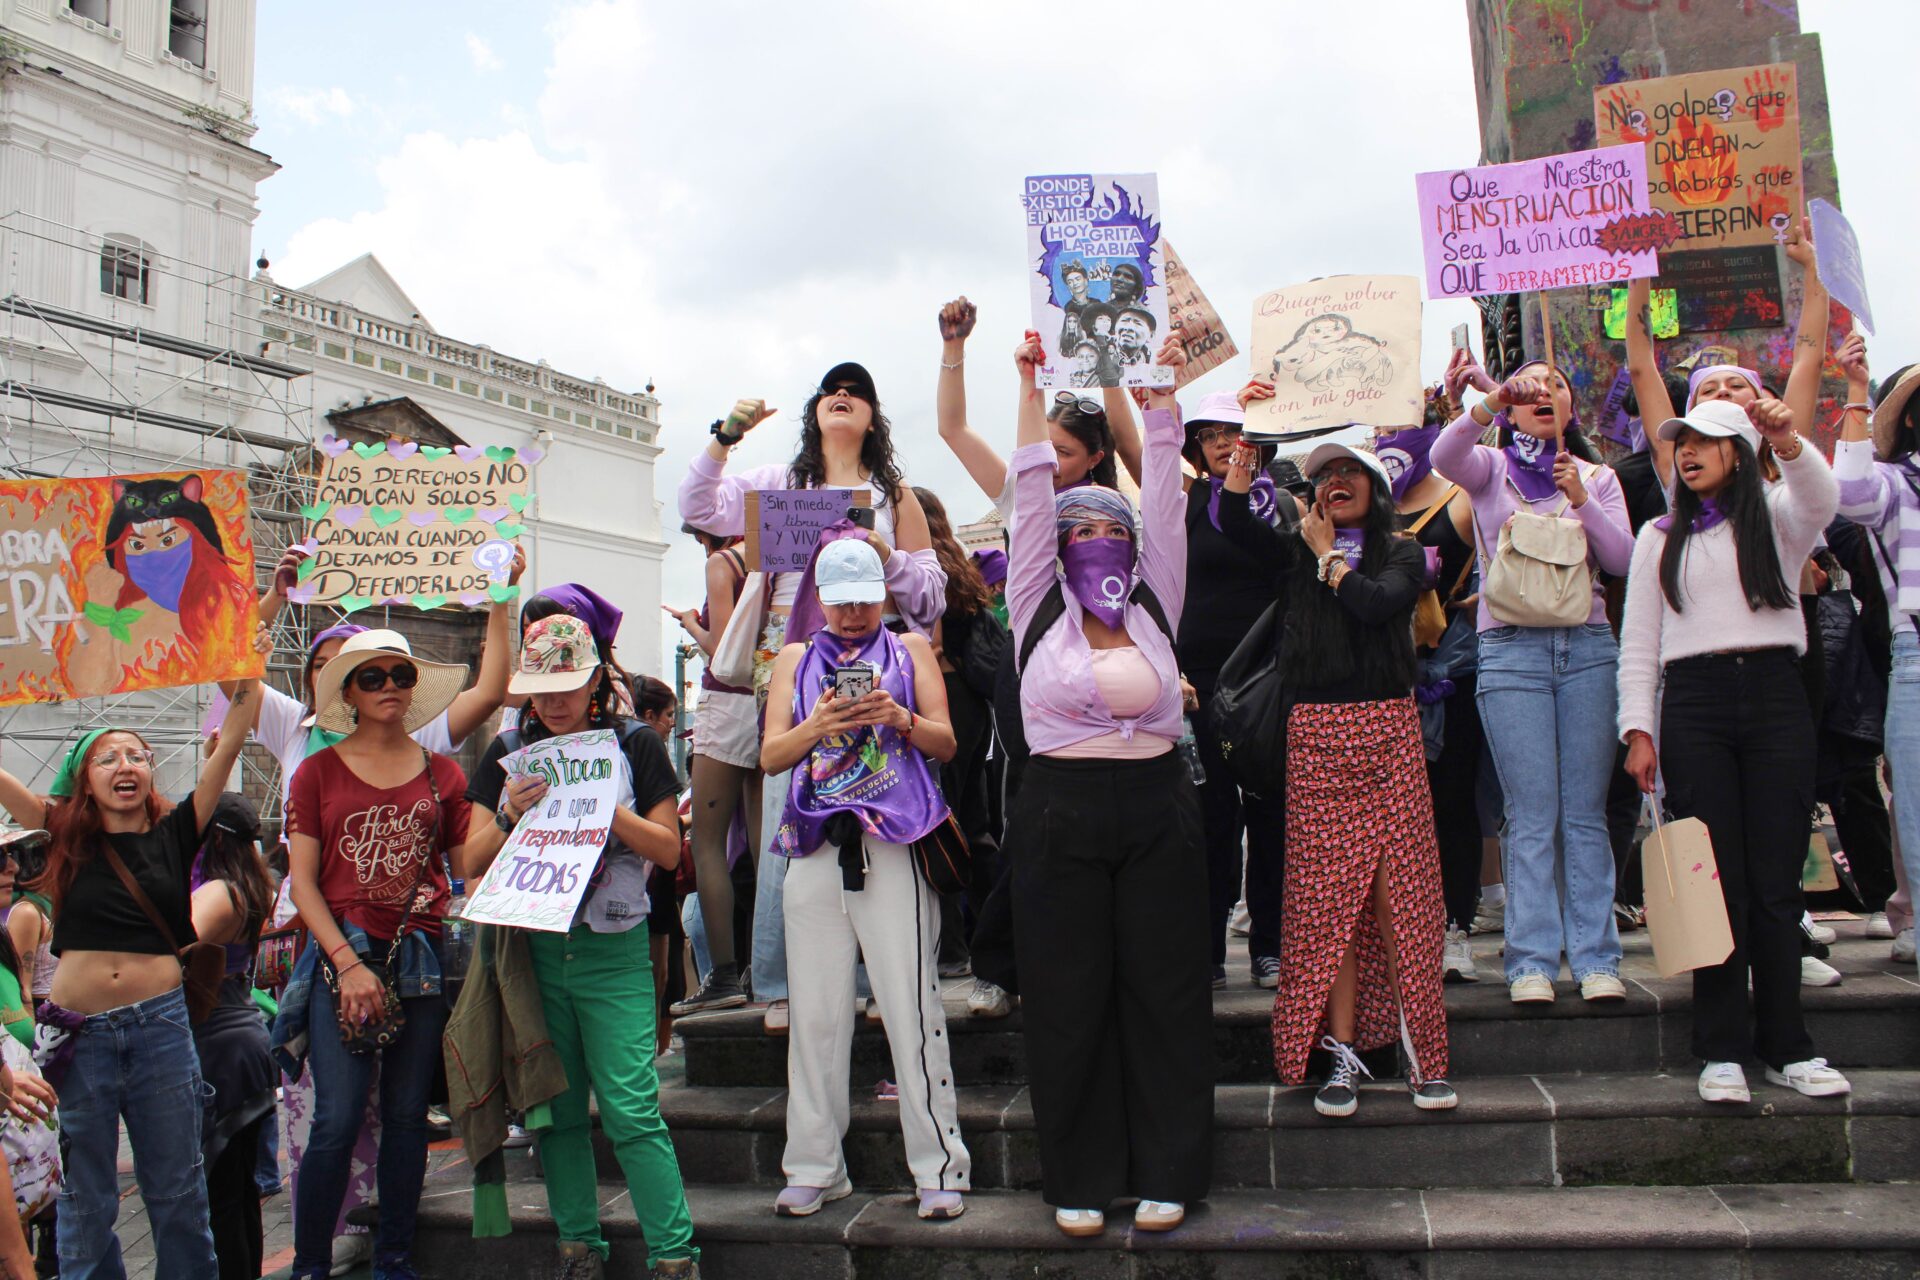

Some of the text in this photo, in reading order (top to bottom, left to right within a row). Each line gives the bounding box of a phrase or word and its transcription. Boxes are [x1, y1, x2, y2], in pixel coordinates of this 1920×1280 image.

[1654, 88, 1731, 136] golpes
[1746, 91, 1786, 121] que
[1028, 178, 1089, 194] DONDE
[1450, 155, 1631, 203] Que Nuestra
[1755, 169, 1793, 195] que
[1021, 192, 1085, 210] EXISTIÓ
[1437, 178, 1636, 236] MENSTRUACIÓN
[1028, 207, 1113, 225] EL MIEDO
[1674, 204, 1763, 240] IERAN
[1050, 223, 1142, 242] HOY GRITA
[1443, 231, 1487, 261] Sea
[1527, 225, 1602, 255] única
[1610, 223, 1667, 241] SANGRE
[1063, 239, 1138, 257] LA RABIA
[1440, 258, 1633, 294] QUE DERRAMEMOS
[1258, 281, 1399, 317] Quiero volver
[1305, 299, 1362, 317] a casa
[1269, 385, 1387, 414] con mi gato
[326, 457, 528, 486] LOS DERECHOS NO
[320, 485, 415, 506] CADUCAN
[767, 495, 833, 511] Sin miedo
[311, 518, 487, 547] CADUCAN CUANDO
[0, 528, 78, 582] BRA
[315, 550, 466, 567] DEJAMOS DE
[311, 569, 490, 601] DEFENDERLOS
[557, 749, 612, 787] tocan
[857, 777, 900, 805] NCESTRAS
[547, 798, 598, 820] a una
[340, 798, 432, 858] Hard
[518, 818, 608, 857] respondemos
[354, 838, 431, 884] Rock
[505, 855, 581, 895] TODAS
